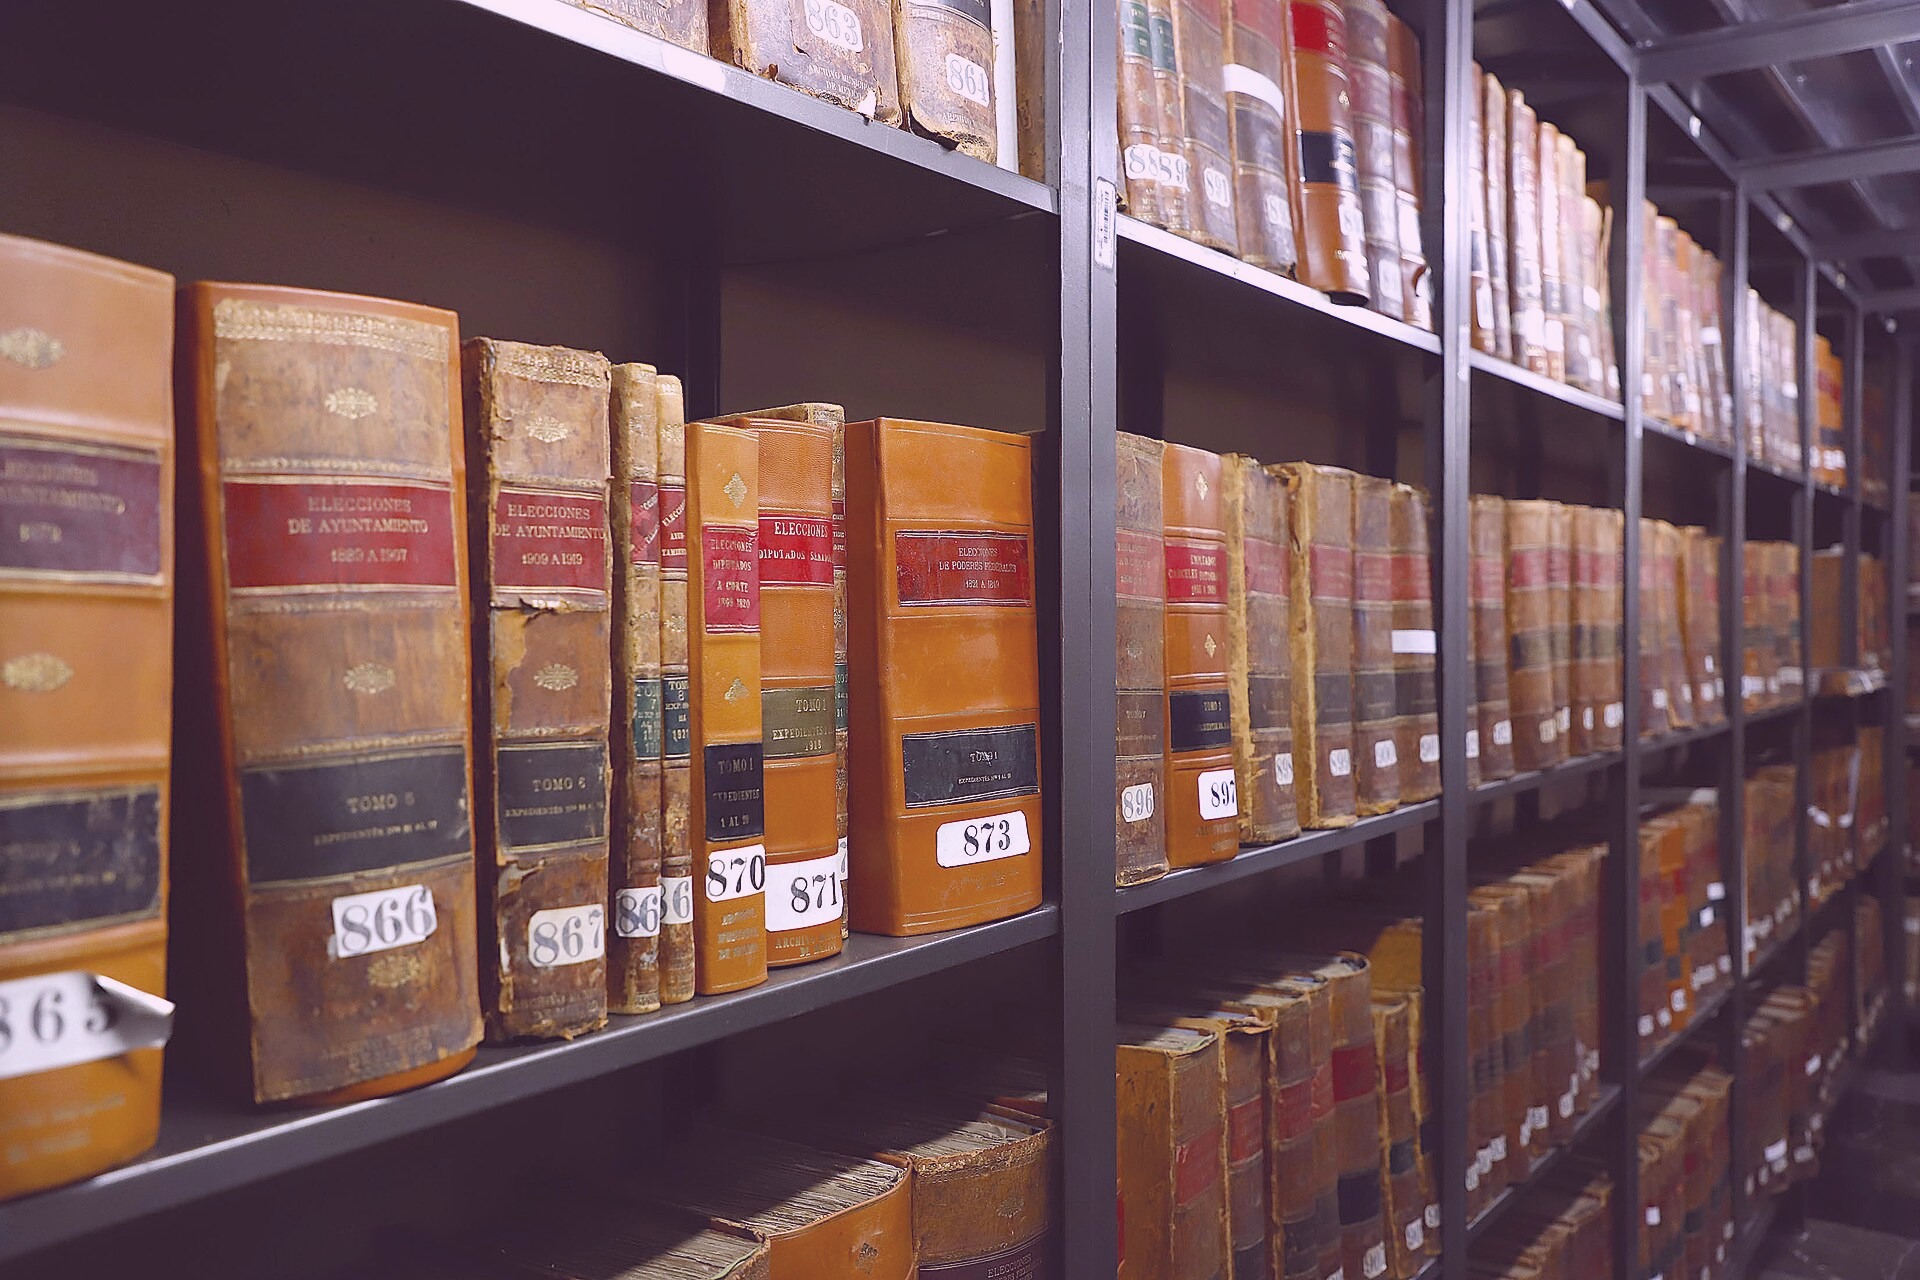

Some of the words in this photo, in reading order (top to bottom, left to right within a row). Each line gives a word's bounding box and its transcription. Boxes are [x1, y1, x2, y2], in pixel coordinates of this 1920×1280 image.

[805, 0, 859, 46] 863
[949, 59, 987, 103] 864
[307, 496, 413, 513] ELECCIONES
[507, 503, 591, 521] ELECCIONES
[287, 518, 314, 535] DE
[317, 517, 430, 534] AYUNTAMIENTO
[774, 521, 829, 539] ELECCIONES
[521, 552, 549, 566] 1909
[551, 553, 561, 566] A
[561, 552, 584, 566] 1919
[951, 561, 983, 571] PODERES
[795, 699, 822, 713] TOMO
[718, 758, 747, 776] TOMO
[532, 777, 574, 793] TOMO
[346, 792, 399, 814] TOMO
[1123, 788, 1154, 819] 896
[963, 819, 1012, 857] 873
[707, 854, 766, 897] 870
[790, 871, 838, 914] 871
[341, 887, 435, 953] 866
[532, 908, 604, 965] 867
